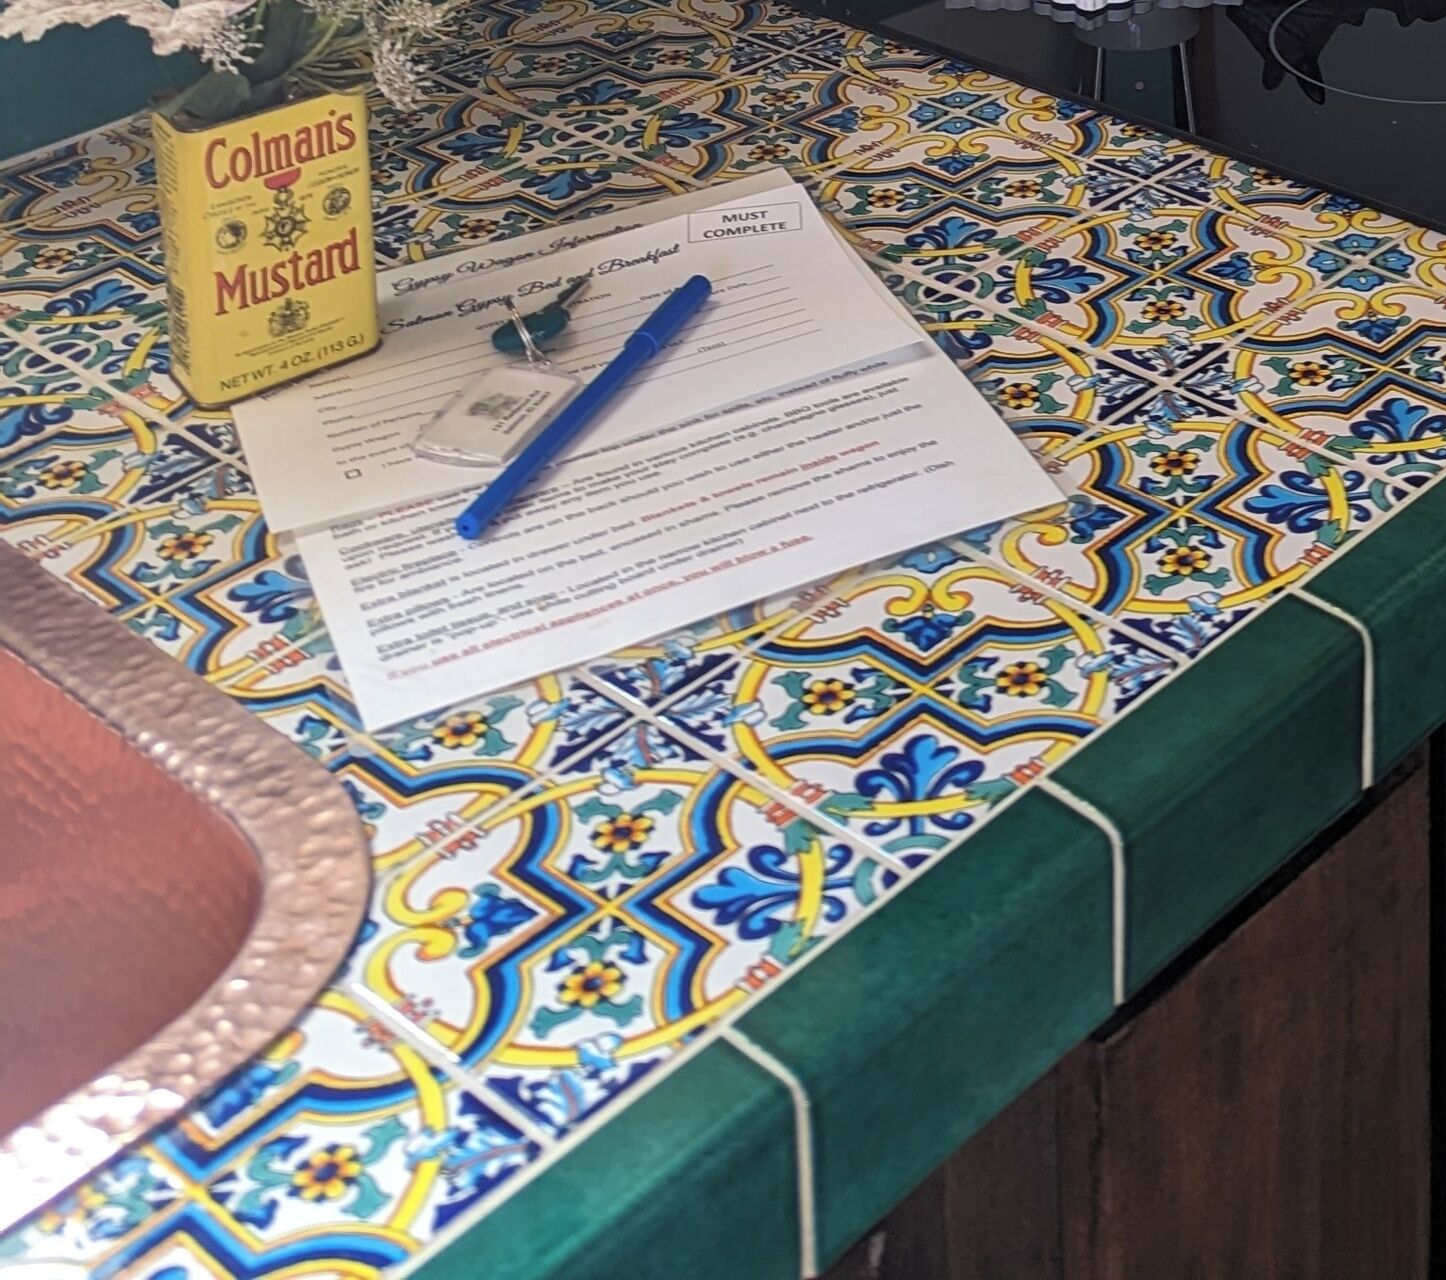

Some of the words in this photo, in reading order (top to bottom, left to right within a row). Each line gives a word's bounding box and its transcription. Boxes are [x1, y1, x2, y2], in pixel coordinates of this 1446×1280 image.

[205, 108, 357, 190] Colman's
[703, 221, 787, 239] COMPLETE
[722, 210, 769, 224] MUST
[213, 226, 361, 317] Mustard
[380, 310, 453, 335] Salmon
[456, 293, 514, 317] Gypsy
[518, 277, 562, 298] Bed
[597, 243, 681, 276] Breakfast
[392, 271, 454, 297] Gypsy
[456, 251, 535, 274] Wagon
[220, 369, 251, 392] NET
[251, 362, 277, 383] WT.
[279, 359, 289, 370] 4
[291, 351, 314, 368] OZ.
[317, 343, 345, 360] (113
